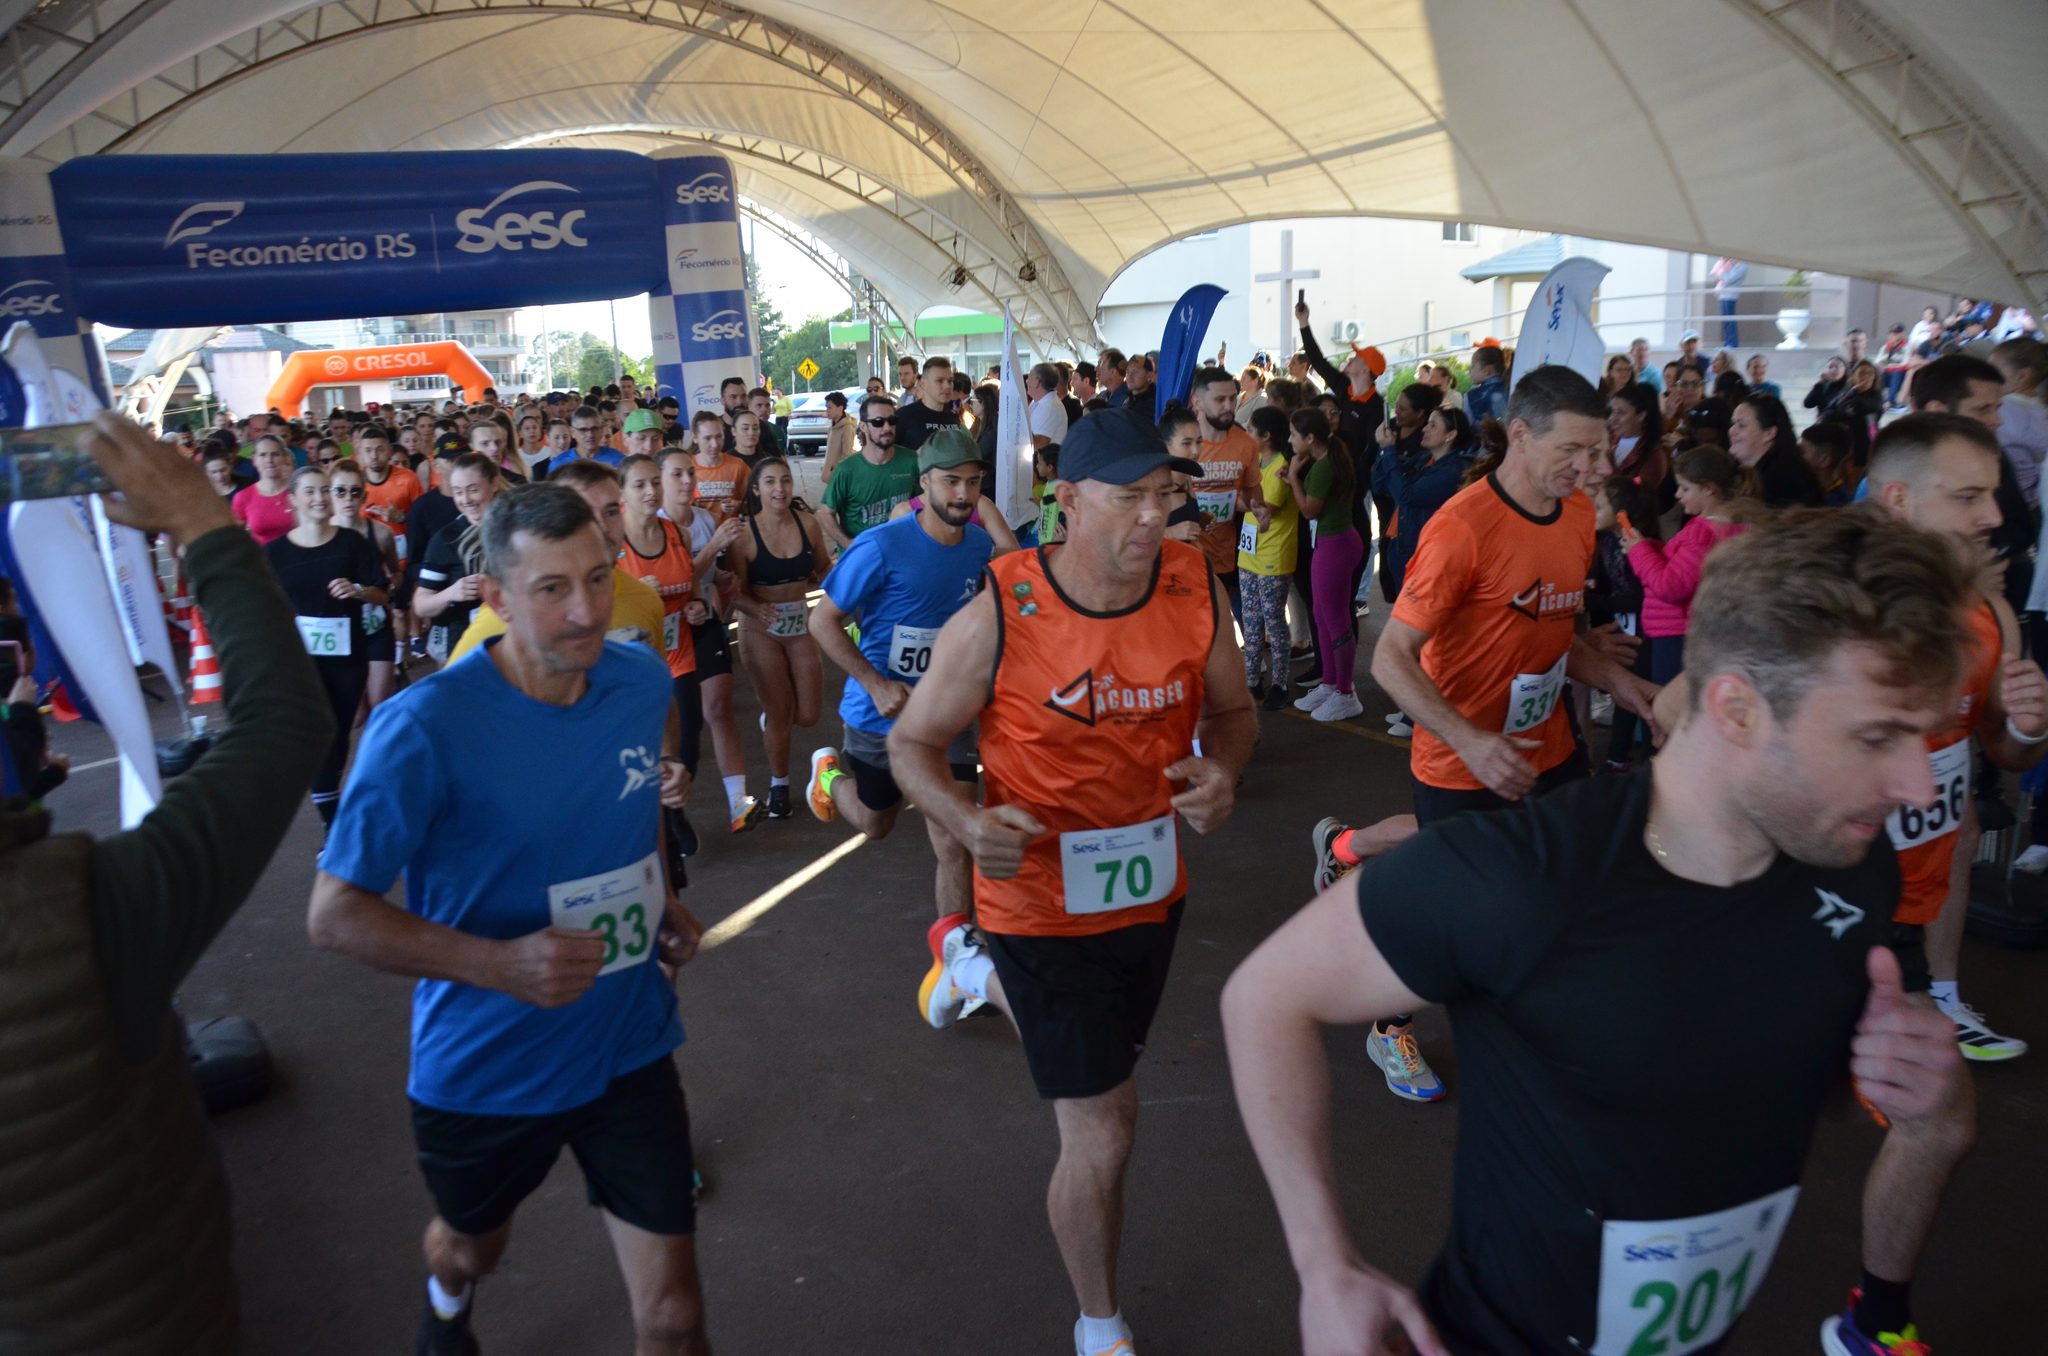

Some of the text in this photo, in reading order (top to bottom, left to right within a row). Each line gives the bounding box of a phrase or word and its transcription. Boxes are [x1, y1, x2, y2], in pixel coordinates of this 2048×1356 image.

[676, 184, 730, 205] Sesc
[455, 208, 588, 253] Sesc
[187, 232, 417, 269] Fecomércio RS
[680, 259, 731, 270] Fecomércio
[691, 321, 745, 342] Sesc
[353, 351, 433, 371] CRESOL
[775, 614, 804, 634] 275
[311, 632, 337, 652] 76
[1072, 842, 1102, 854] Sesc
[1095, 855, 1152, 904] 70
[591, 903, 648, 966] 33
[1625, 1249, 1757, 1356] 201
